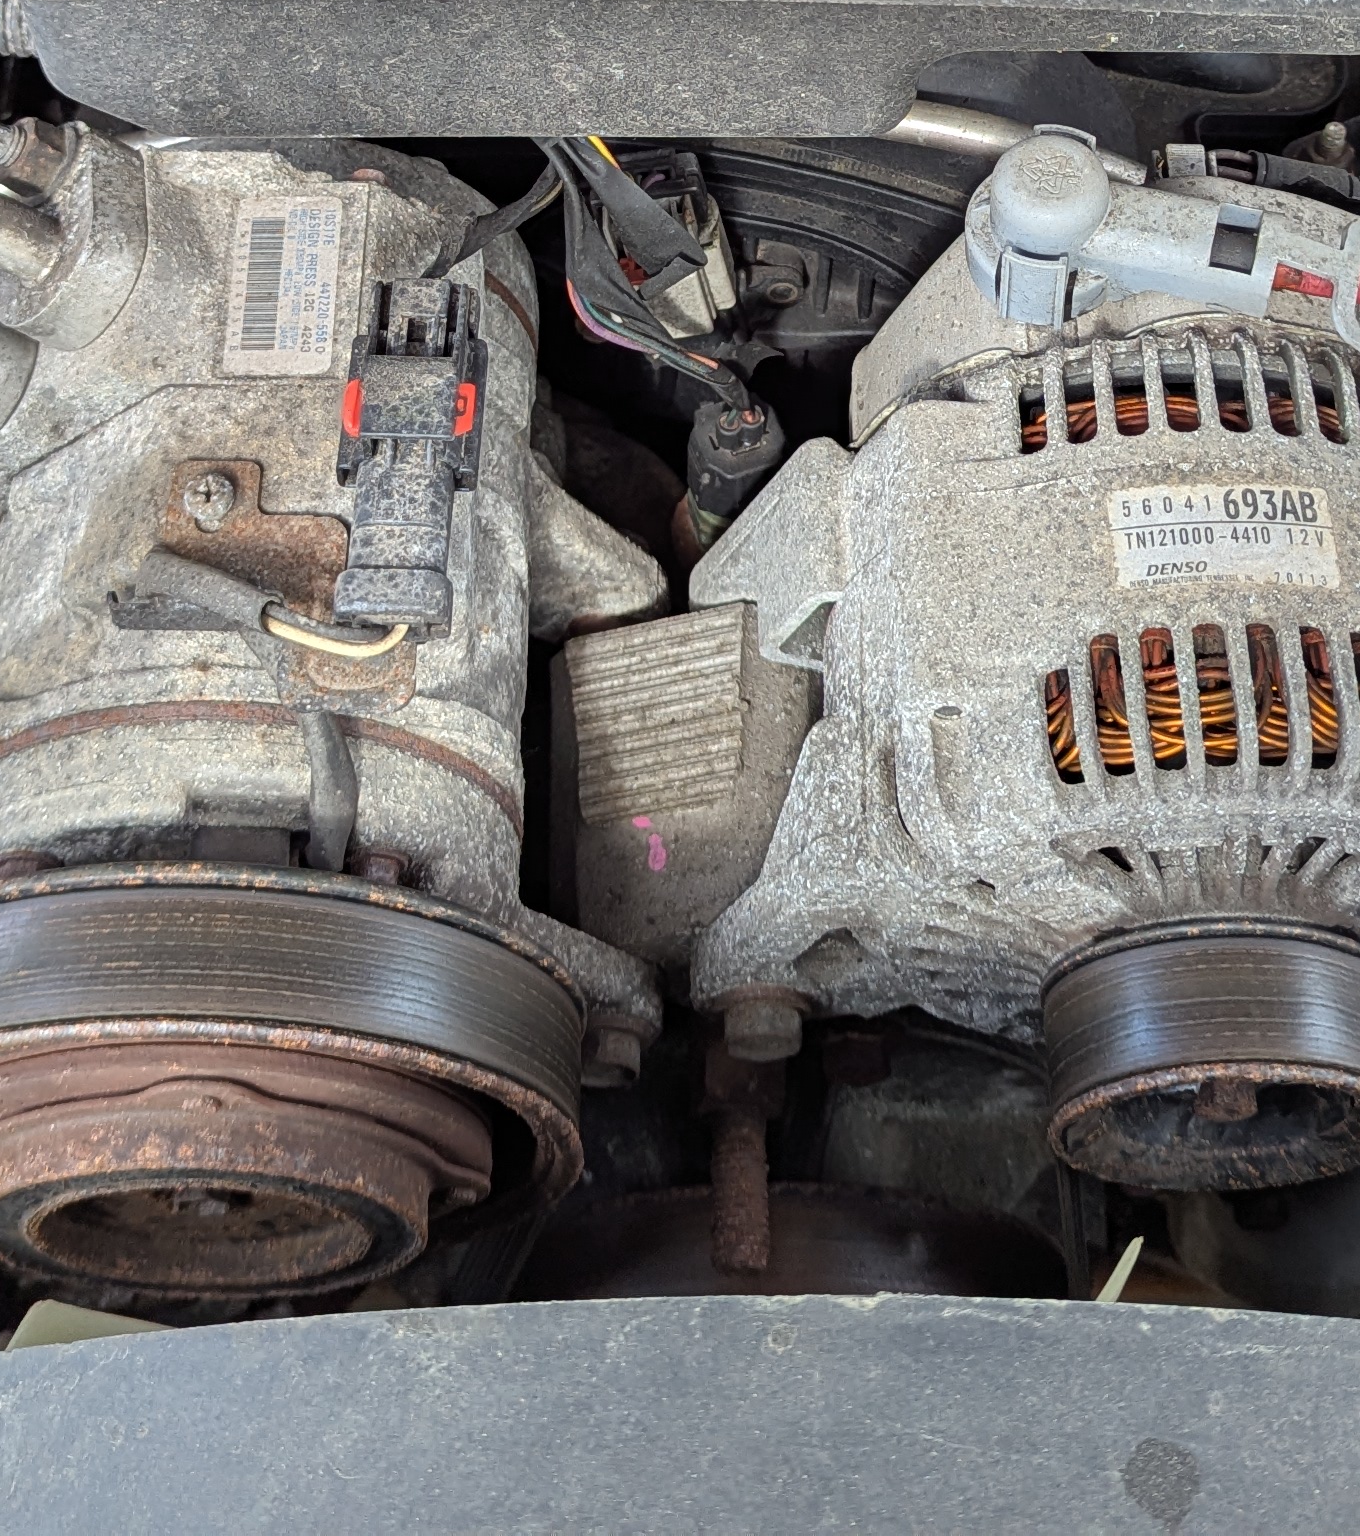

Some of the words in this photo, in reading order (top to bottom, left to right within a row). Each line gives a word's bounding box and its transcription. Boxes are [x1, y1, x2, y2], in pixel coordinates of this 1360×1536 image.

[307, 209, 321, 248] DESIGN
[323, 209, 336, 246] 10S17E
[304, 253, 318, 287] PRESS
[300, 325, 313, 353] 4243
[1122, 494, 1211, 518] 56041
[1222, 487, 1318, 523] 693AB
[1124, 526, 1271, 550] TN121000-4410
[1286, 527, 1324, 547] 12V
[1146, 560, 1208, 577] DENSO
[1274, 571, 1328, 587] 70113
